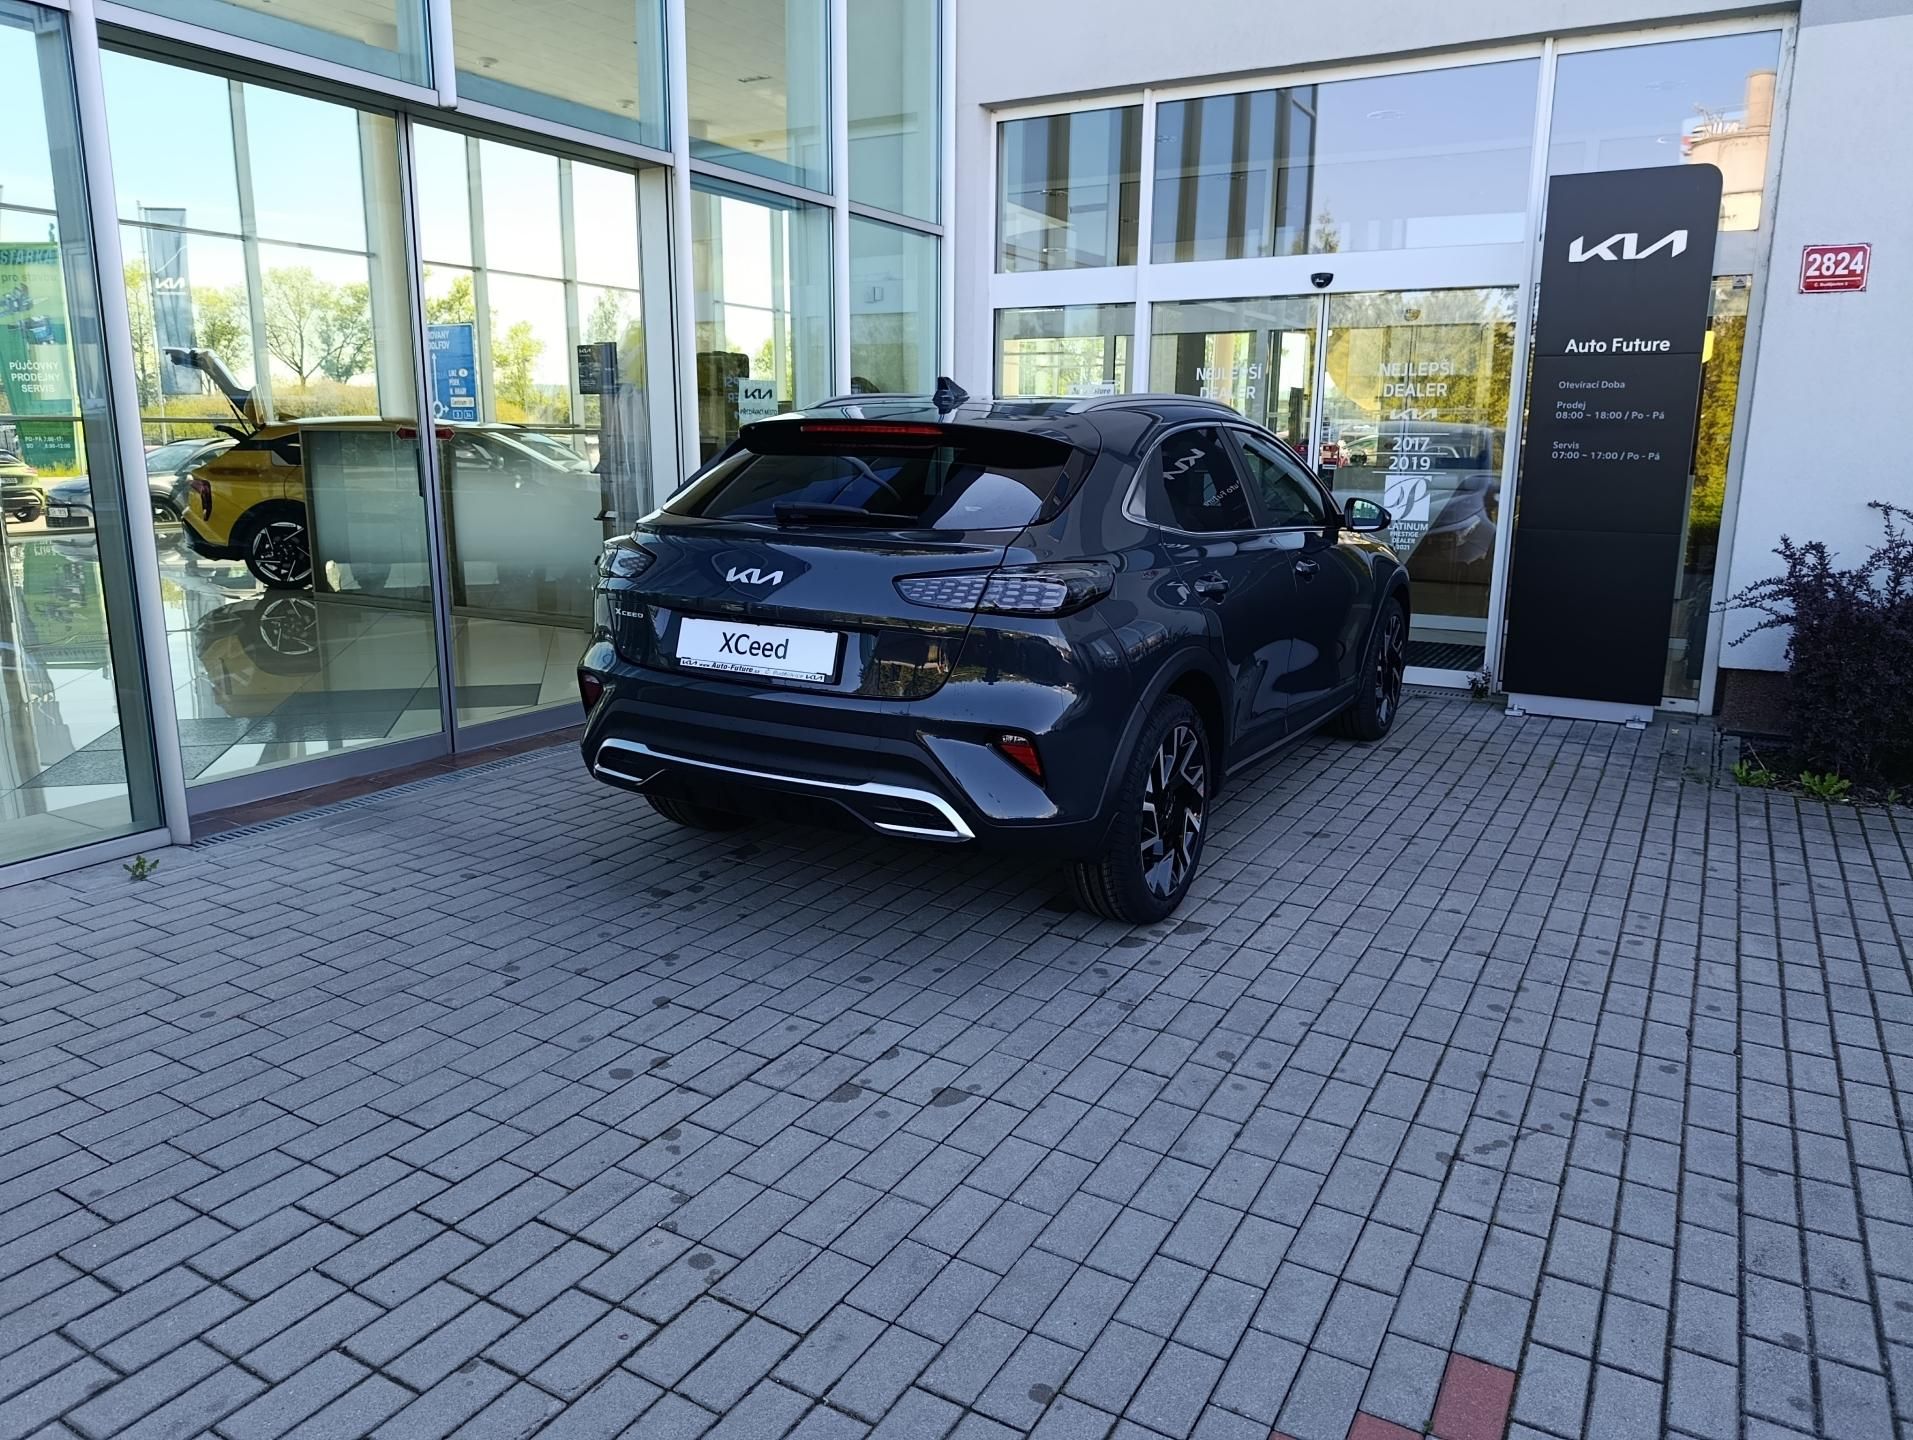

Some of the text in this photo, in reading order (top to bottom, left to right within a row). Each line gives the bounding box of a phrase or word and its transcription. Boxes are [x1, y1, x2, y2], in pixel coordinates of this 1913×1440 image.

[1568, 229, 1688, 263] KIA
[1806, 251, 1864, 276] 2824
[428, 330, 449, 340] OVANY
[1564, 338, 1671, 353] Auto Future
[21, 384, 56, 393] SERVIS
[1383, 383, 1448, 397] DEALER
[1600, 381, 1626, 389] Doba
[744, 388, 773, 400] KIA
[1556, 401, 1586, 410] Prodej
[1555, 411, 1584, 419] 08:00
[1594, 411, 1622, 420] 18:00
[1393, 437, 1430, 451] 2017
[1552, 441, 1580, 449] Servis
[1551, 451, 1580, 459] 07:00
[1590, 451, 1618, 460] 17:00
[1626, 452, 1640, 460] Po
[1388, 456, 1431, 470] 2019
[1387, 522, 1428, 530] LATINUM
[726, 566, 783, 586] KIA
[718, 631, 790, 660] XCeed
[711, 662, 754, 673] Auto-Future
